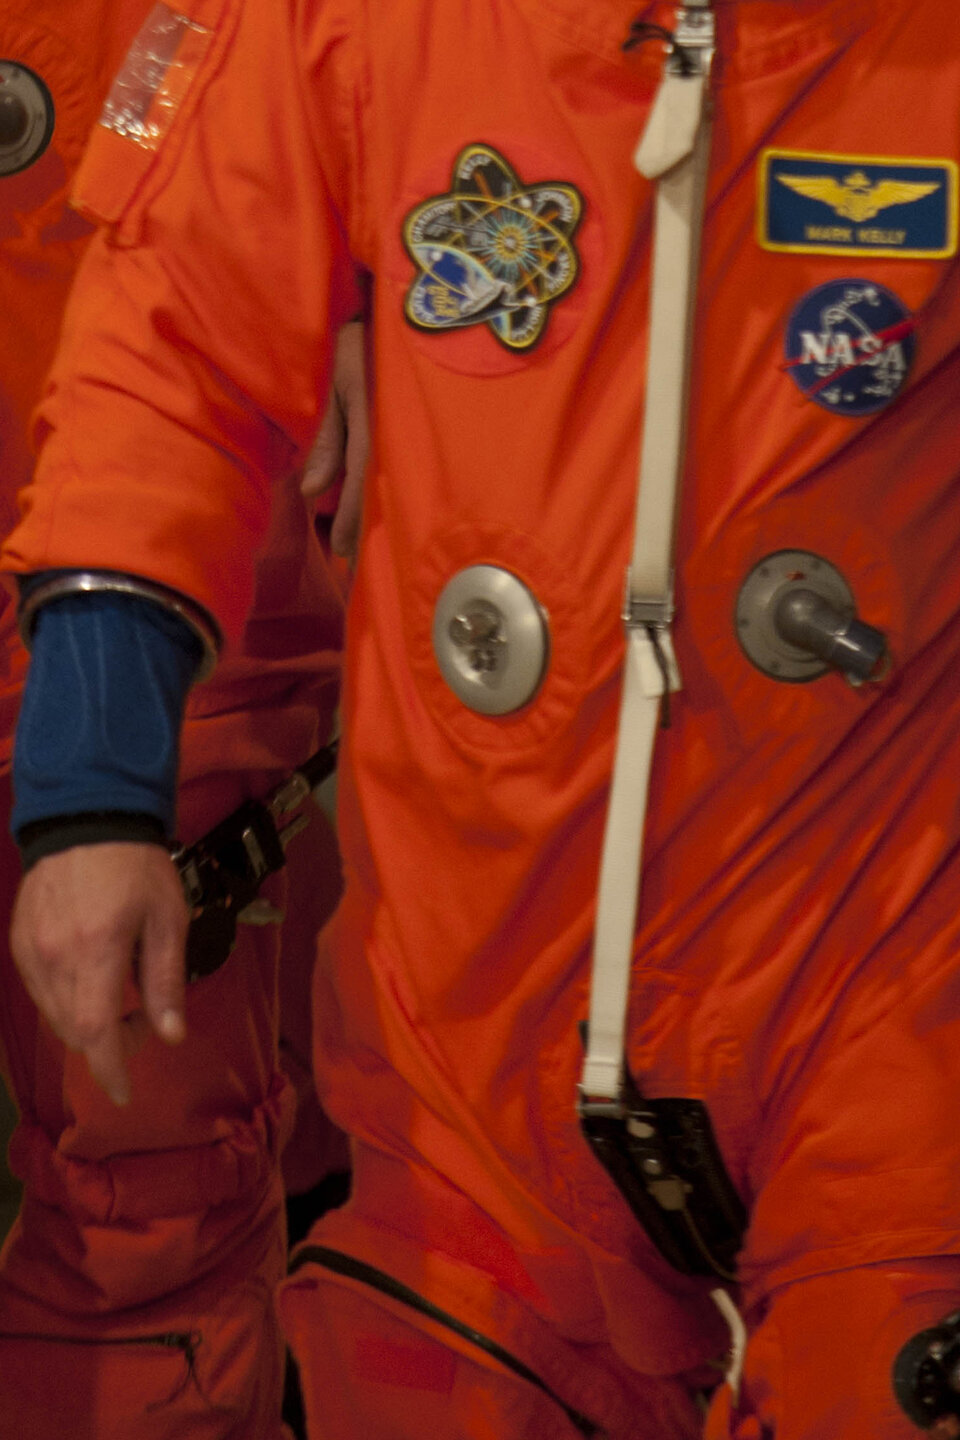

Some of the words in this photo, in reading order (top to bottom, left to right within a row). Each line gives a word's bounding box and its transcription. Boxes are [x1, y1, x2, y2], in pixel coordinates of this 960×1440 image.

[804, 226, 853, 243] MARK
[857, 228, 906, 245] KELLY
[800, 331, 906, 371] NASA
